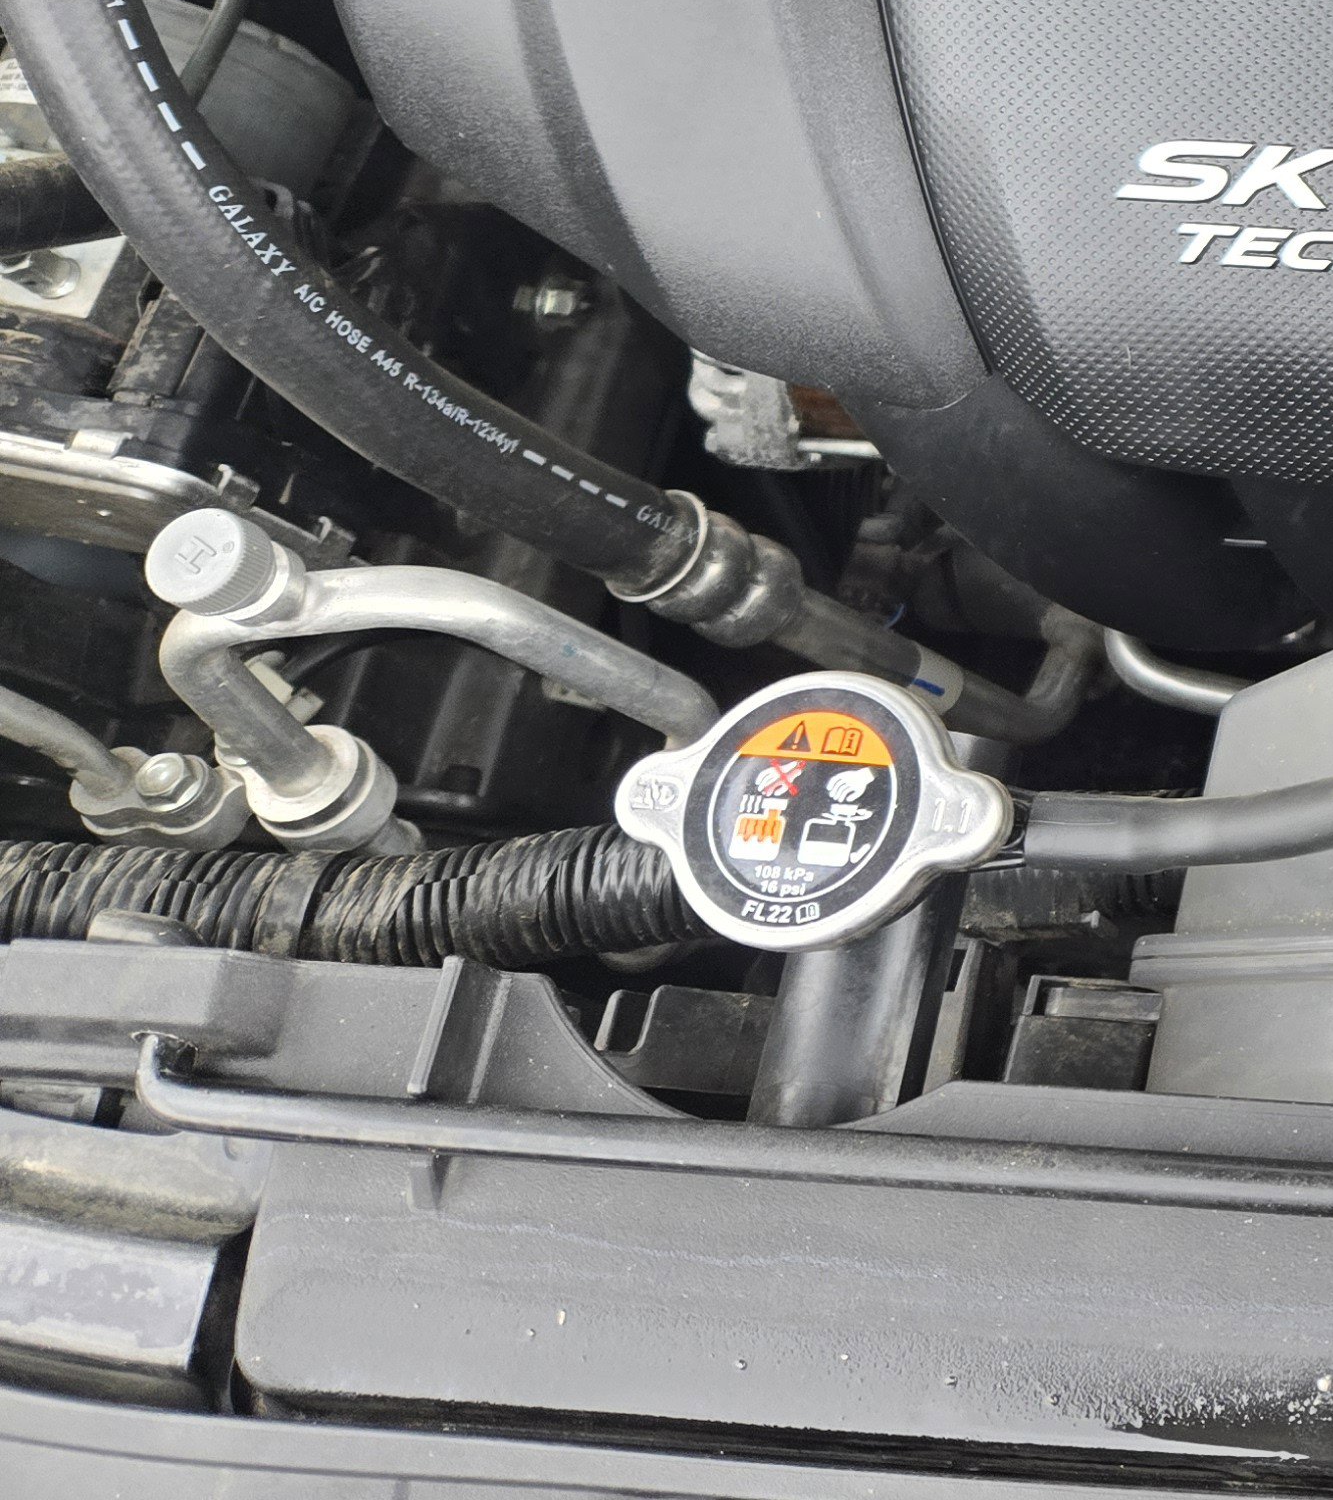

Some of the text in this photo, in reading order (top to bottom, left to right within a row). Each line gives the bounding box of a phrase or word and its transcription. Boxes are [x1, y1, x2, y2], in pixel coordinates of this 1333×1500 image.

[207, 183, 298, 279] GALAXY
[294, 282, 326, 315] A/C
[325, 307, 373, 354] HOSE
[369, 348, 404, 378] A45
[174, 534, 218, 576] H
[754, 864, 815, 882] 108 kPa
[760, 879, 807, 898] 16 psi
[740, 899, 793, 924] FL22
